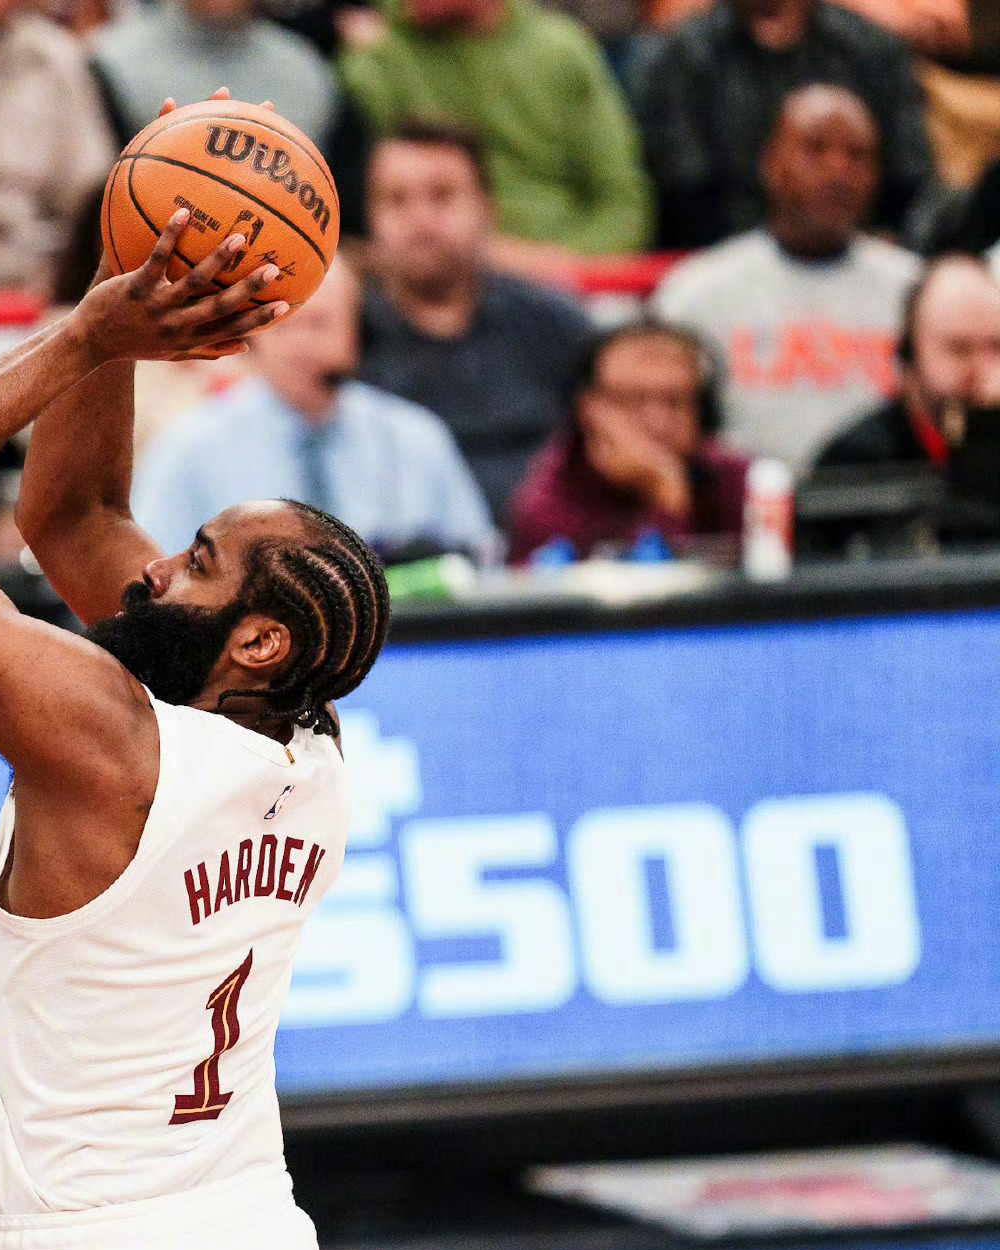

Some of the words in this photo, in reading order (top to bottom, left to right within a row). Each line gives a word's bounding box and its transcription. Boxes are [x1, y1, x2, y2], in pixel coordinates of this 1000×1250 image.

[204, 124, 331, 236] Wilson
[184, 834, 326, 926] HARDEN
[168, 946, 253, 1125] 1
